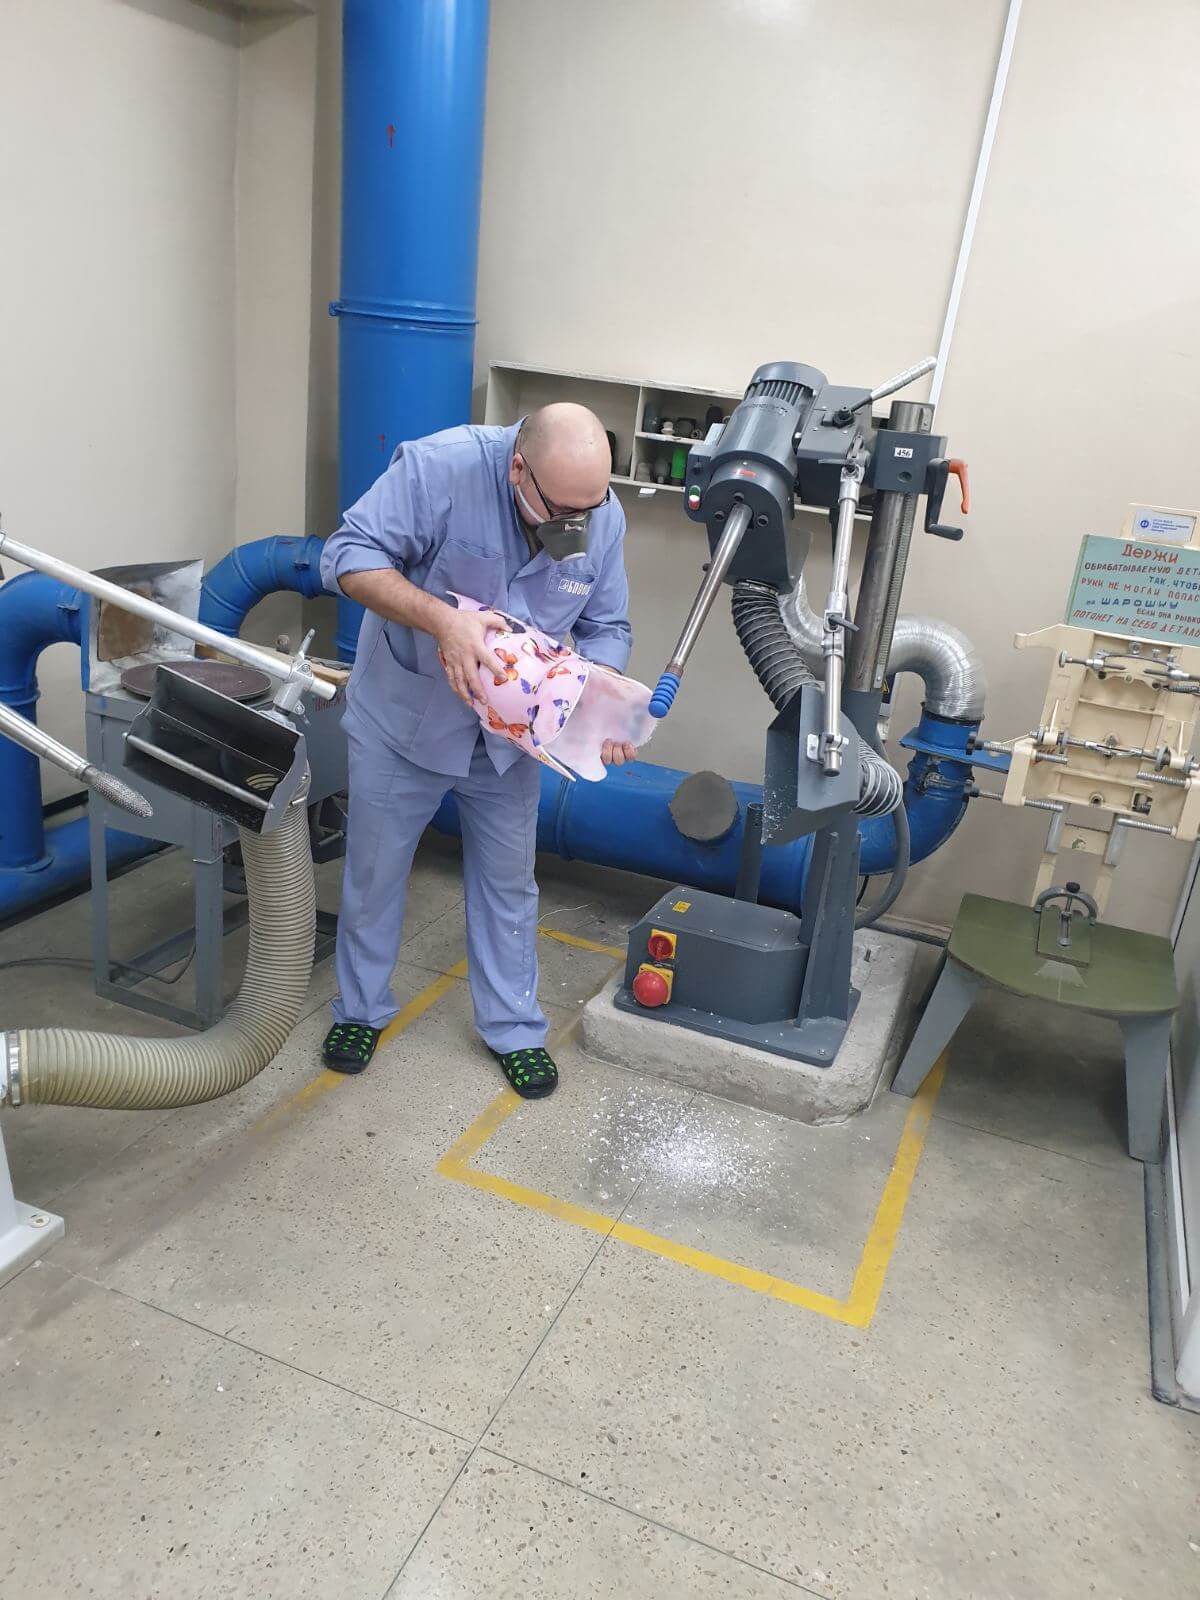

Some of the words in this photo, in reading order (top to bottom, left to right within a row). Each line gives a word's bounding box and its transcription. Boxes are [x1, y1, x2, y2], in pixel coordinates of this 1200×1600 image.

[1084, 562, 1171, 574] ОБРАБАТЫВАЕМУЮ
[1176, 567, 1200, 576] ДЕТ
[1081, 577, 1104, 588] РУКИ
[1108, 581, 1120, 590] НЕ
[1123, 583, 1160, 596] МОГЛИ
[1101, 598, 1178, 609] ШАРОШКУ
[1136, 608, 1156, 616] ЕСЛИ
[1158, 611, 1171, 619] ОНА
[1115, 616, 1129, 625] НА
